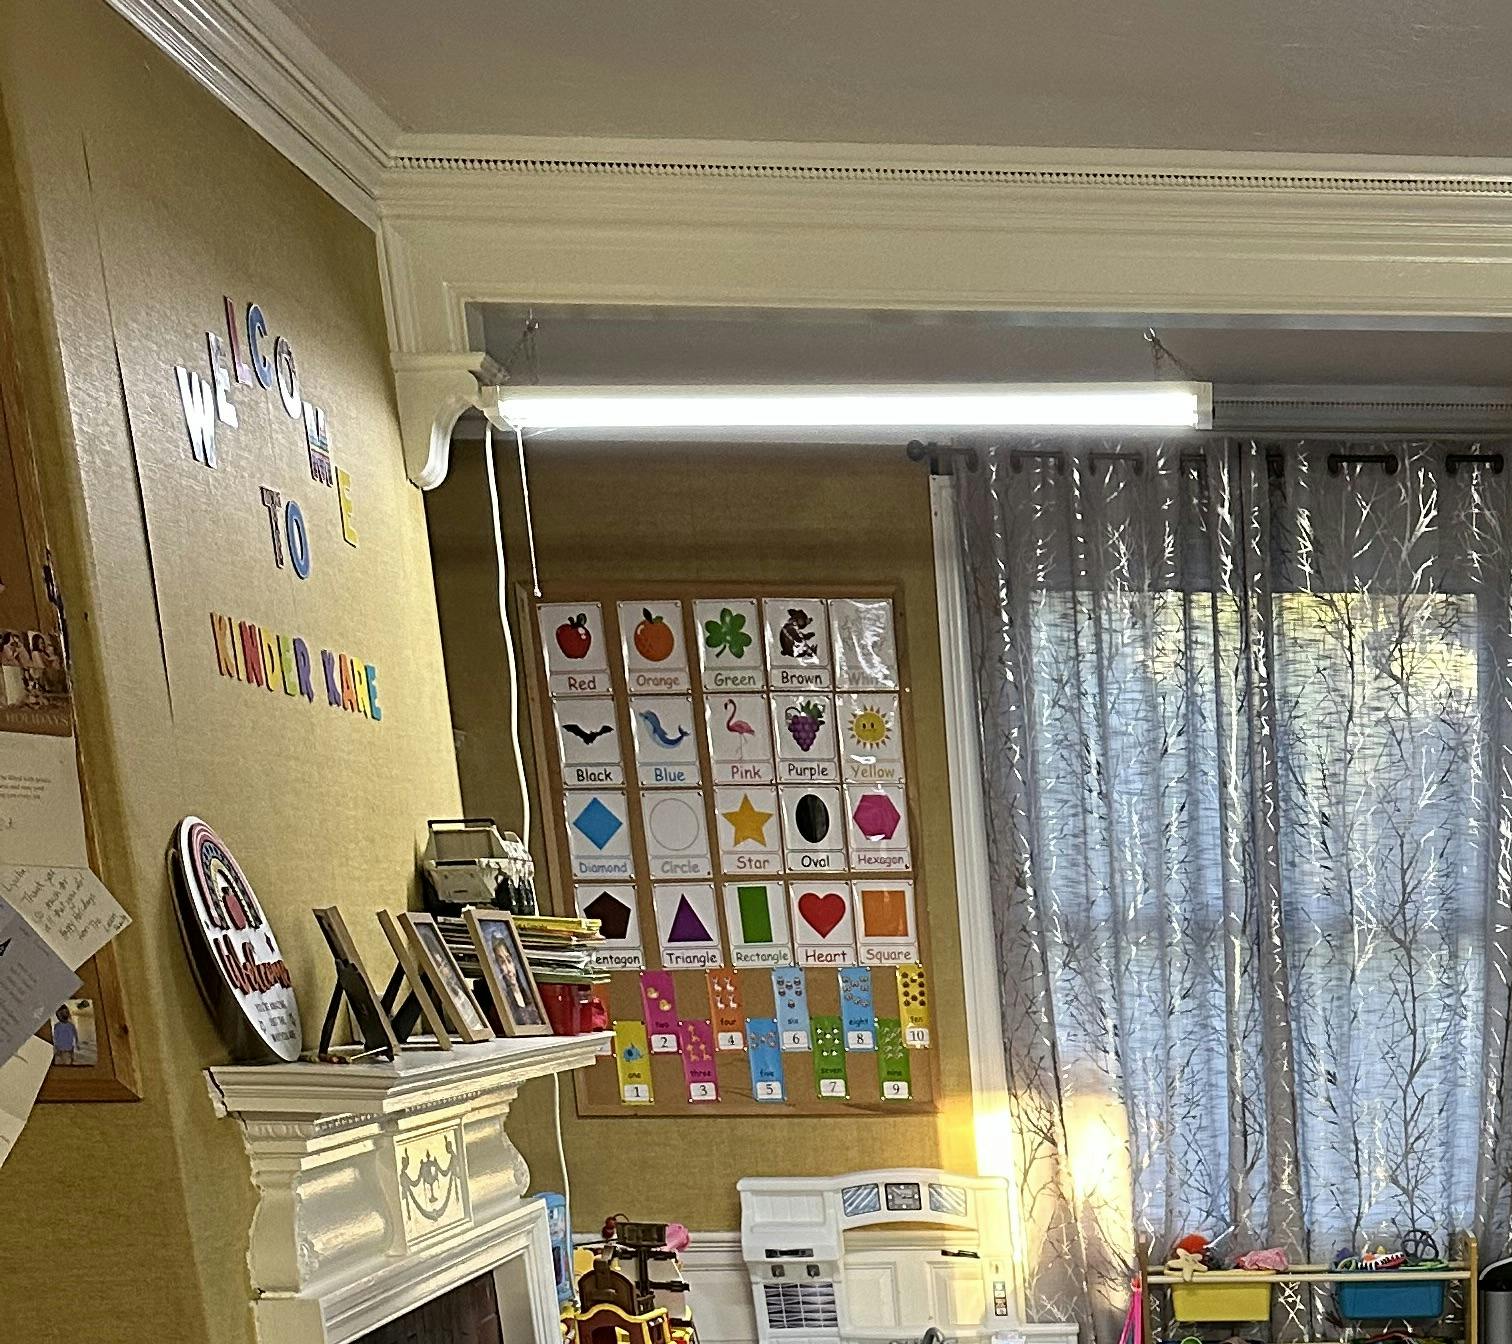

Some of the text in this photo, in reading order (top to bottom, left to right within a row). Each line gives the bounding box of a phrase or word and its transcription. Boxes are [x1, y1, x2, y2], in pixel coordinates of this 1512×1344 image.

[174, 295, 358, 549] WELCOME
[260, 485, 310, 580] TO
[210, 612, 381, 721] KINDER KARE
[568, 677, 596, 691] Red
[637, 674, 680, 688] Orange
[714, 673, 756, 687] Green
[781, 671, 822, 686] Brown
[576, 768, 613, 783] Black
[655, 768, 686, 782] Blue
[731, 765, 762, 780] Pink
[788, 763, 829, 779] Purple
[851, 764, 895, 779] Yellow
[579, 861, 628, 874] Diamond
[736, 856, 770, 870] Star
[801, 855, 830, 869] Oval
[857, 853, 904, 868] Hexagon
[661, 861, 700, 875] Circle
[666, 951, 717, 966] Triangle
[736, 950, 789, 963] Rectangle
[806, 950, 847, 964] Heart
[866, 948, 912, 962] Square
[660, 1037, 669, 1047] 2
[727, 1036, 736, 1046] 4
[792, 1033, 801, 1045] 6
[856, 1033, 864, 1044] 8
[909, 1030, 924, 1042] 10
[633, 1085, 641, 1098] 1
[699, 1084, 708, 1096] 3
[764, 1083, 773, 1095] 5
[828, 1081, 837, 1093] 7
[892, 1083, 900, 1095] 9
